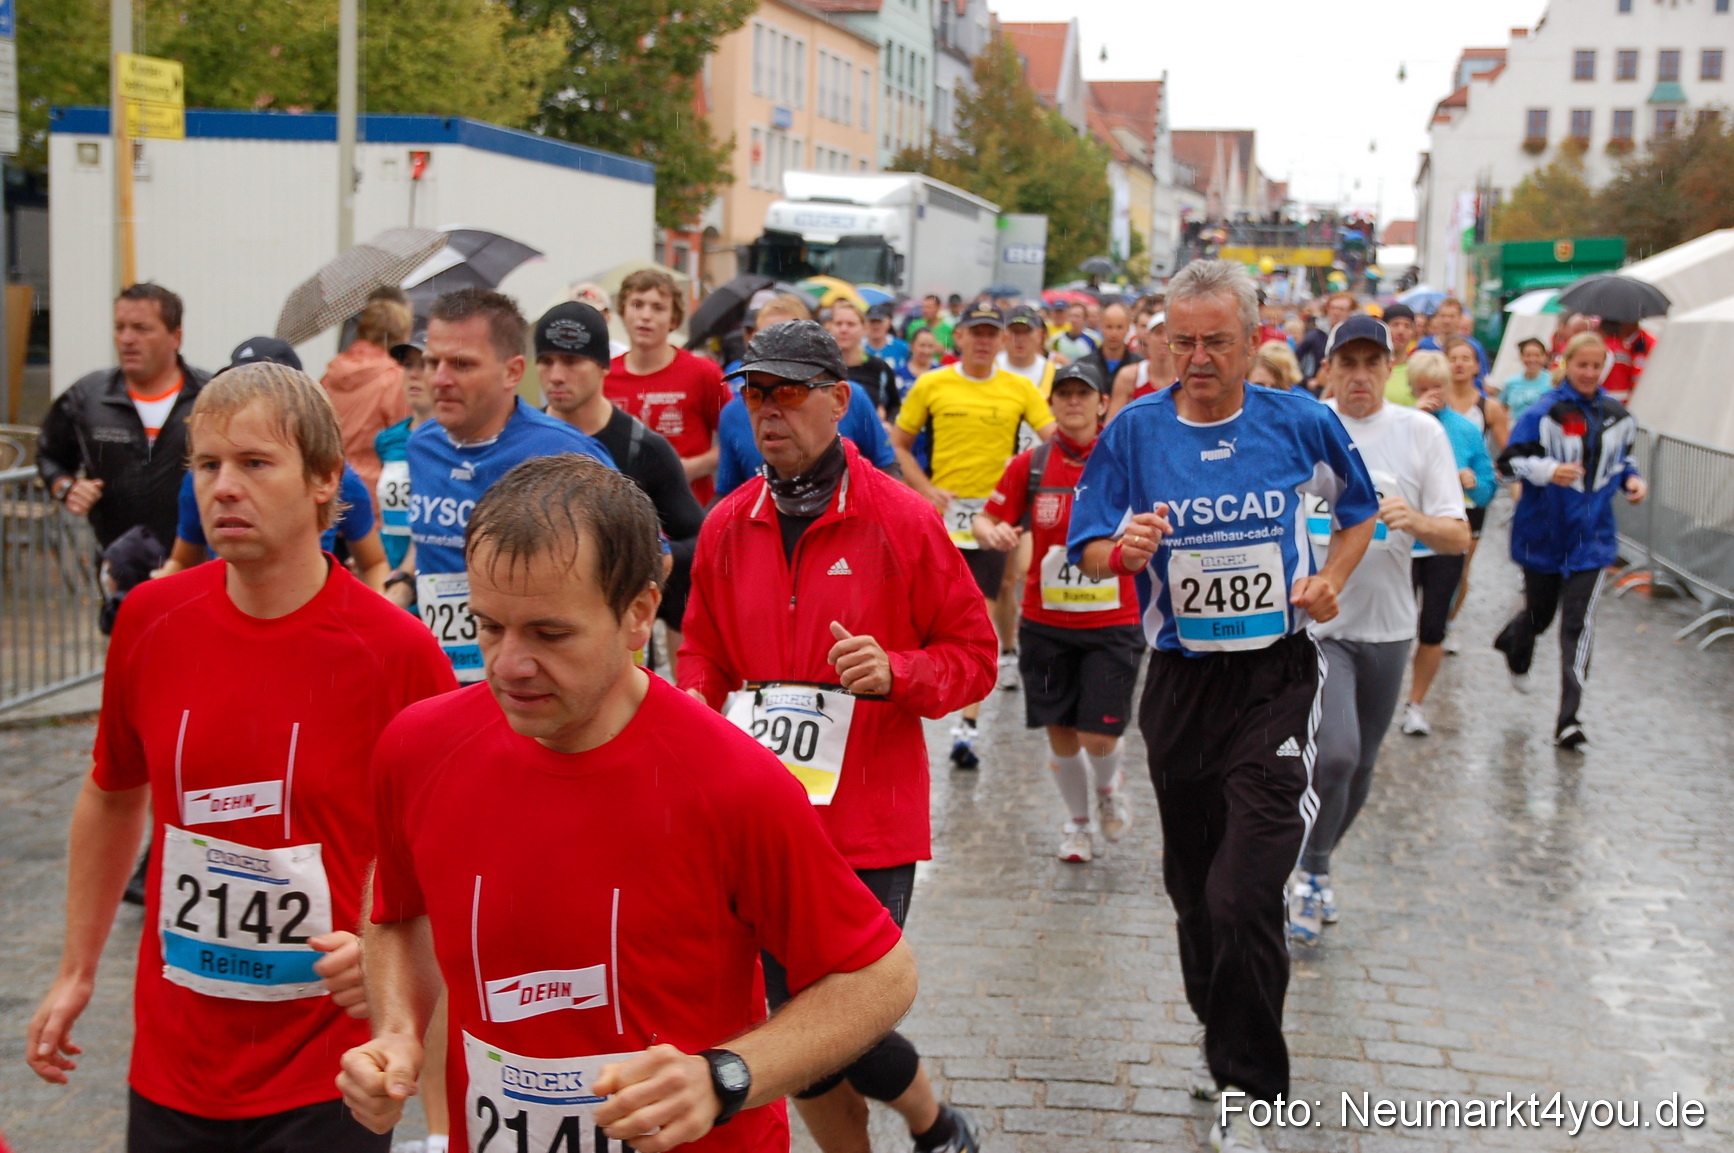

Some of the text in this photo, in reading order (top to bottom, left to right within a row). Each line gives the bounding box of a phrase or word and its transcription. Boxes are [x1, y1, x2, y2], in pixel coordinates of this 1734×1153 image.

[1181, 572, 1274, 613] 2482
[1212, 621, 1246, 637] Emil
[210, 793, 256, 812] DEHN
[206, 848, 271, 873] BOCK
[174, 873, 310, 945] 2142
[200, 949, 276, 980] Reiner
[519, 981, 573, 1006] DEHN
[502, 1064, 584, 1092] BOCK
